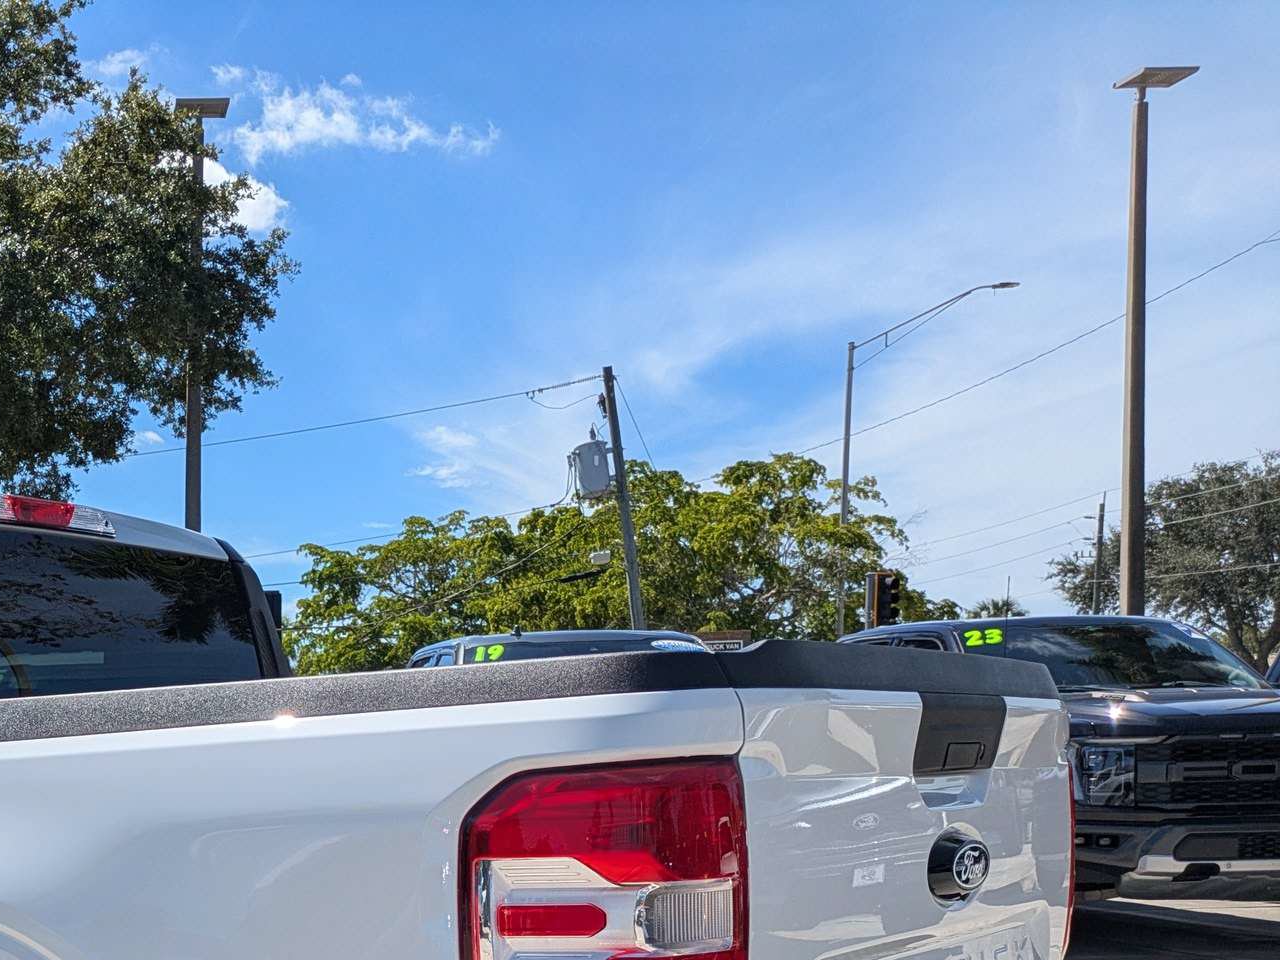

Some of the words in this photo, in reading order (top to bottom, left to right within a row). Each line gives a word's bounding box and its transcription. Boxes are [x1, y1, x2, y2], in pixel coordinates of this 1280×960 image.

[963, 628, 1003, 647] 23
[474, 644, 505, 662] 19
[961, 850, 986, 881] Ford
